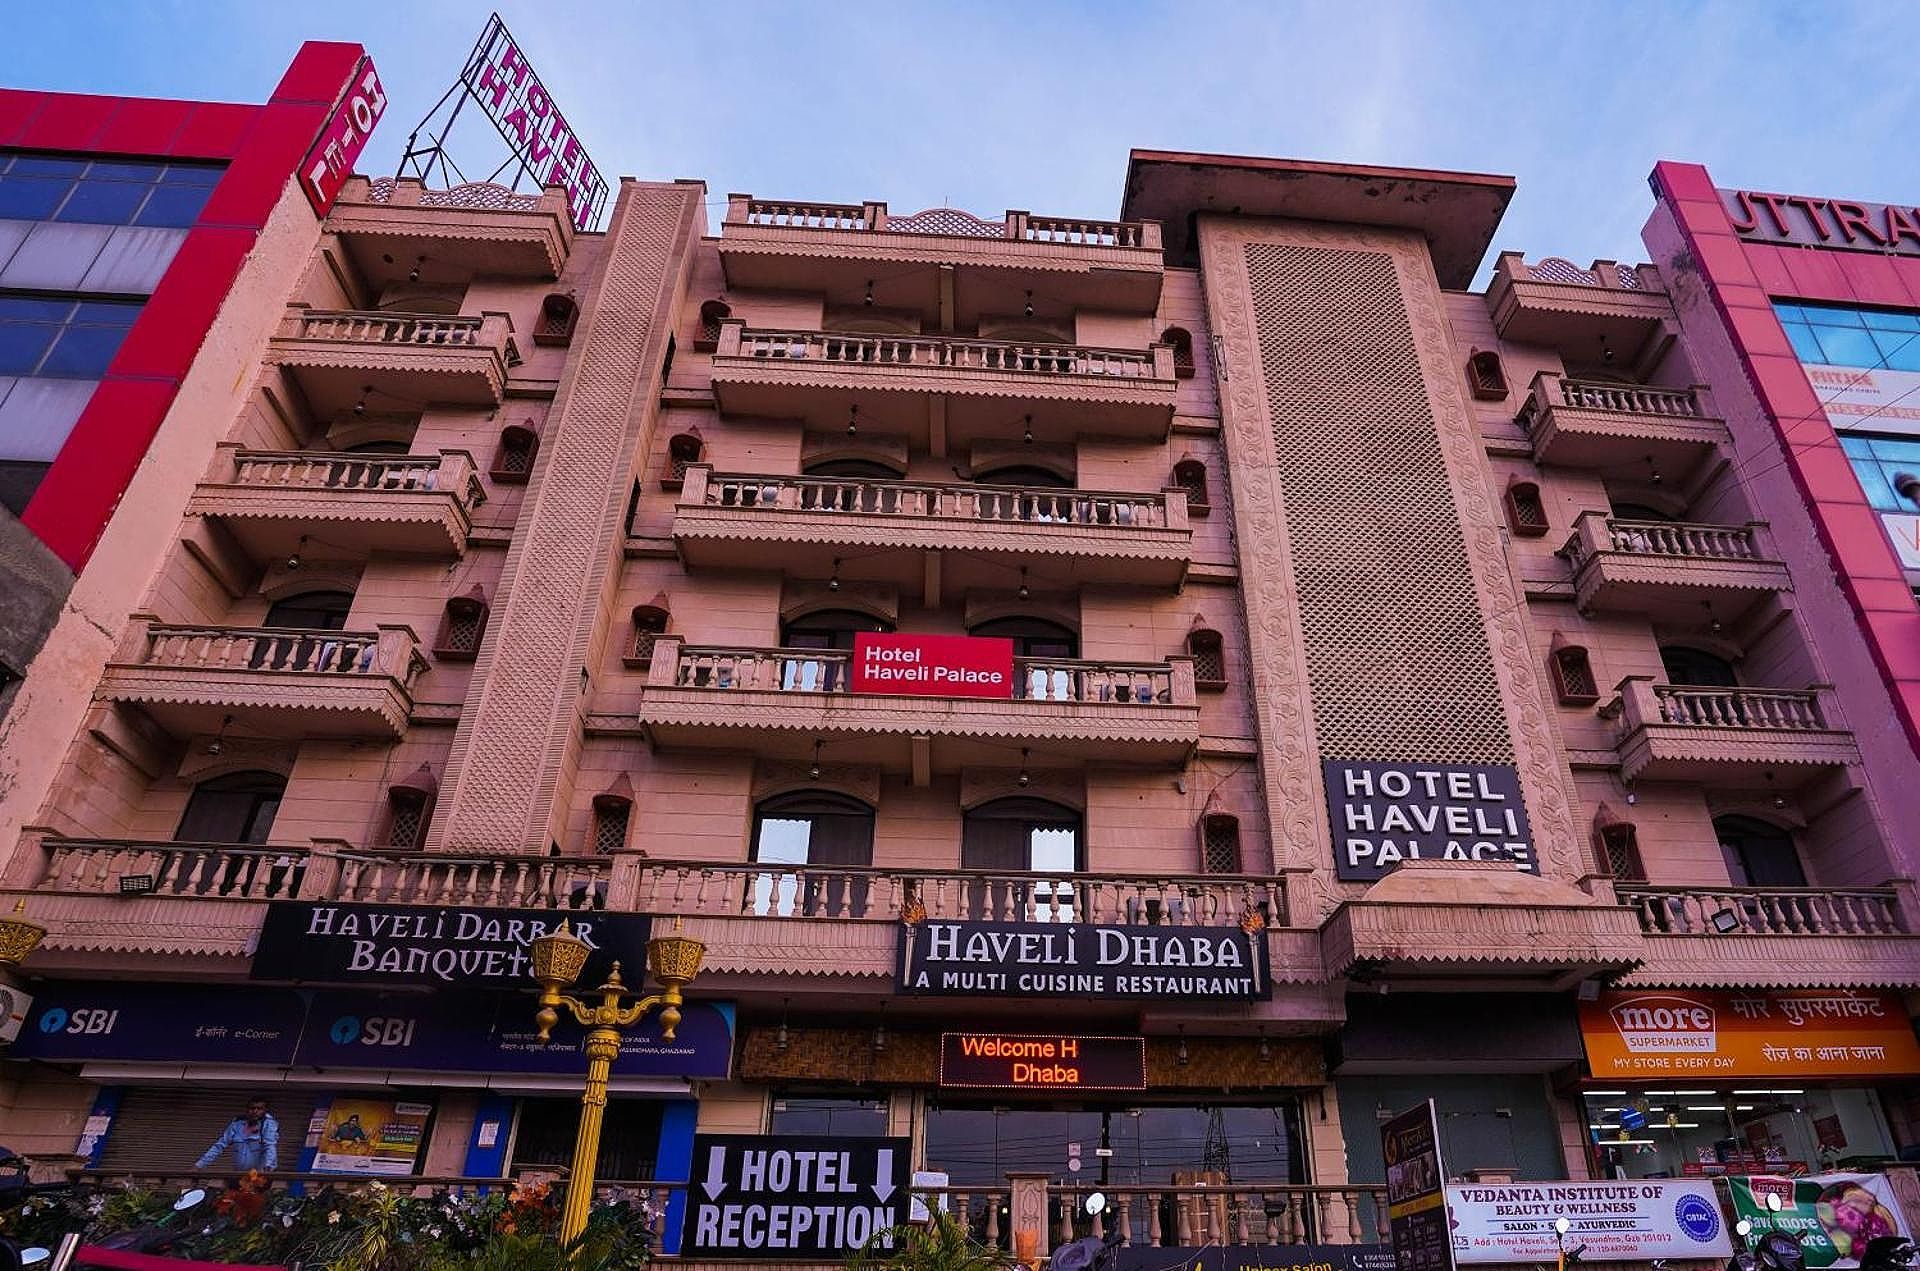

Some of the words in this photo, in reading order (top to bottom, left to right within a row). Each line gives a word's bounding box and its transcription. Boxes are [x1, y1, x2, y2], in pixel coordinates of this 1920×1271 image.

[500, 43, 592, 194] HOTEL
[865, 646, 921, 663] Hotel
[864, 664, 929, 681] Haveli
[933, 666, 1003, 683] Palace
[1344, 769, 1505, 800] HOTEL
[1344, 803, 1519, 836] HAVELI
[1096, 929, 1244, 967] DHABA
[915, 973, 930, 989] A
[942, 972, 1007, 991] MULTI
[1018, 973, 1104, 992] CUISINE
[1116, 975, 1252, 994] RESTAURANT
[66, 1009, 120, 1034] SBI
[1619, 1007, 1711, 1030] more
[360, 1017, 418, 1047] SBI
[962, 1037, 1055, 1058] Welcome
[1061, 1040, 1077, 1058] H
[1630, 1037, 1711, 1048] SUPERMARKET
[1613, 1058, 1631, 1068] MY
[1634, 1058, 1670, 1068] STORE
[1675, 1058, 1711, 1068] EVERY
[1714, 1058, 1736, 1068] DAY
[1791, 1046, 1813, 1061] का
[1816, 1046, 1850, 1061] आना
[1850, 1046, 1885, 1061] जाना
[1013, 1063, 1079, 1083] Dhaba
[740, 1151, 857, 1193] HOTEL
[1460, 1189, 1544, 1203] VEDANTA
[1548, 1186, 1639, 1201] INSTITUTE
[1642, 1186, 1664, 1199] OF
[1757, 1183, 1789, 1193] more
[1496, 1204, 1550, 1216] BEAUTY
[1554, 1204, 1564, 1214] &
[1566, 1202, 1637, 1214] WELLNESS
[695, 1204, 895, 1249] RECEPTION
[1503, 1222, 1538, 1231] SALON
[1578, 1220, 1637, 1230] AYURVEDIC
[1777, 1216, 1819, 1230] more
[1800, 1234, 1828, 1247] ore
